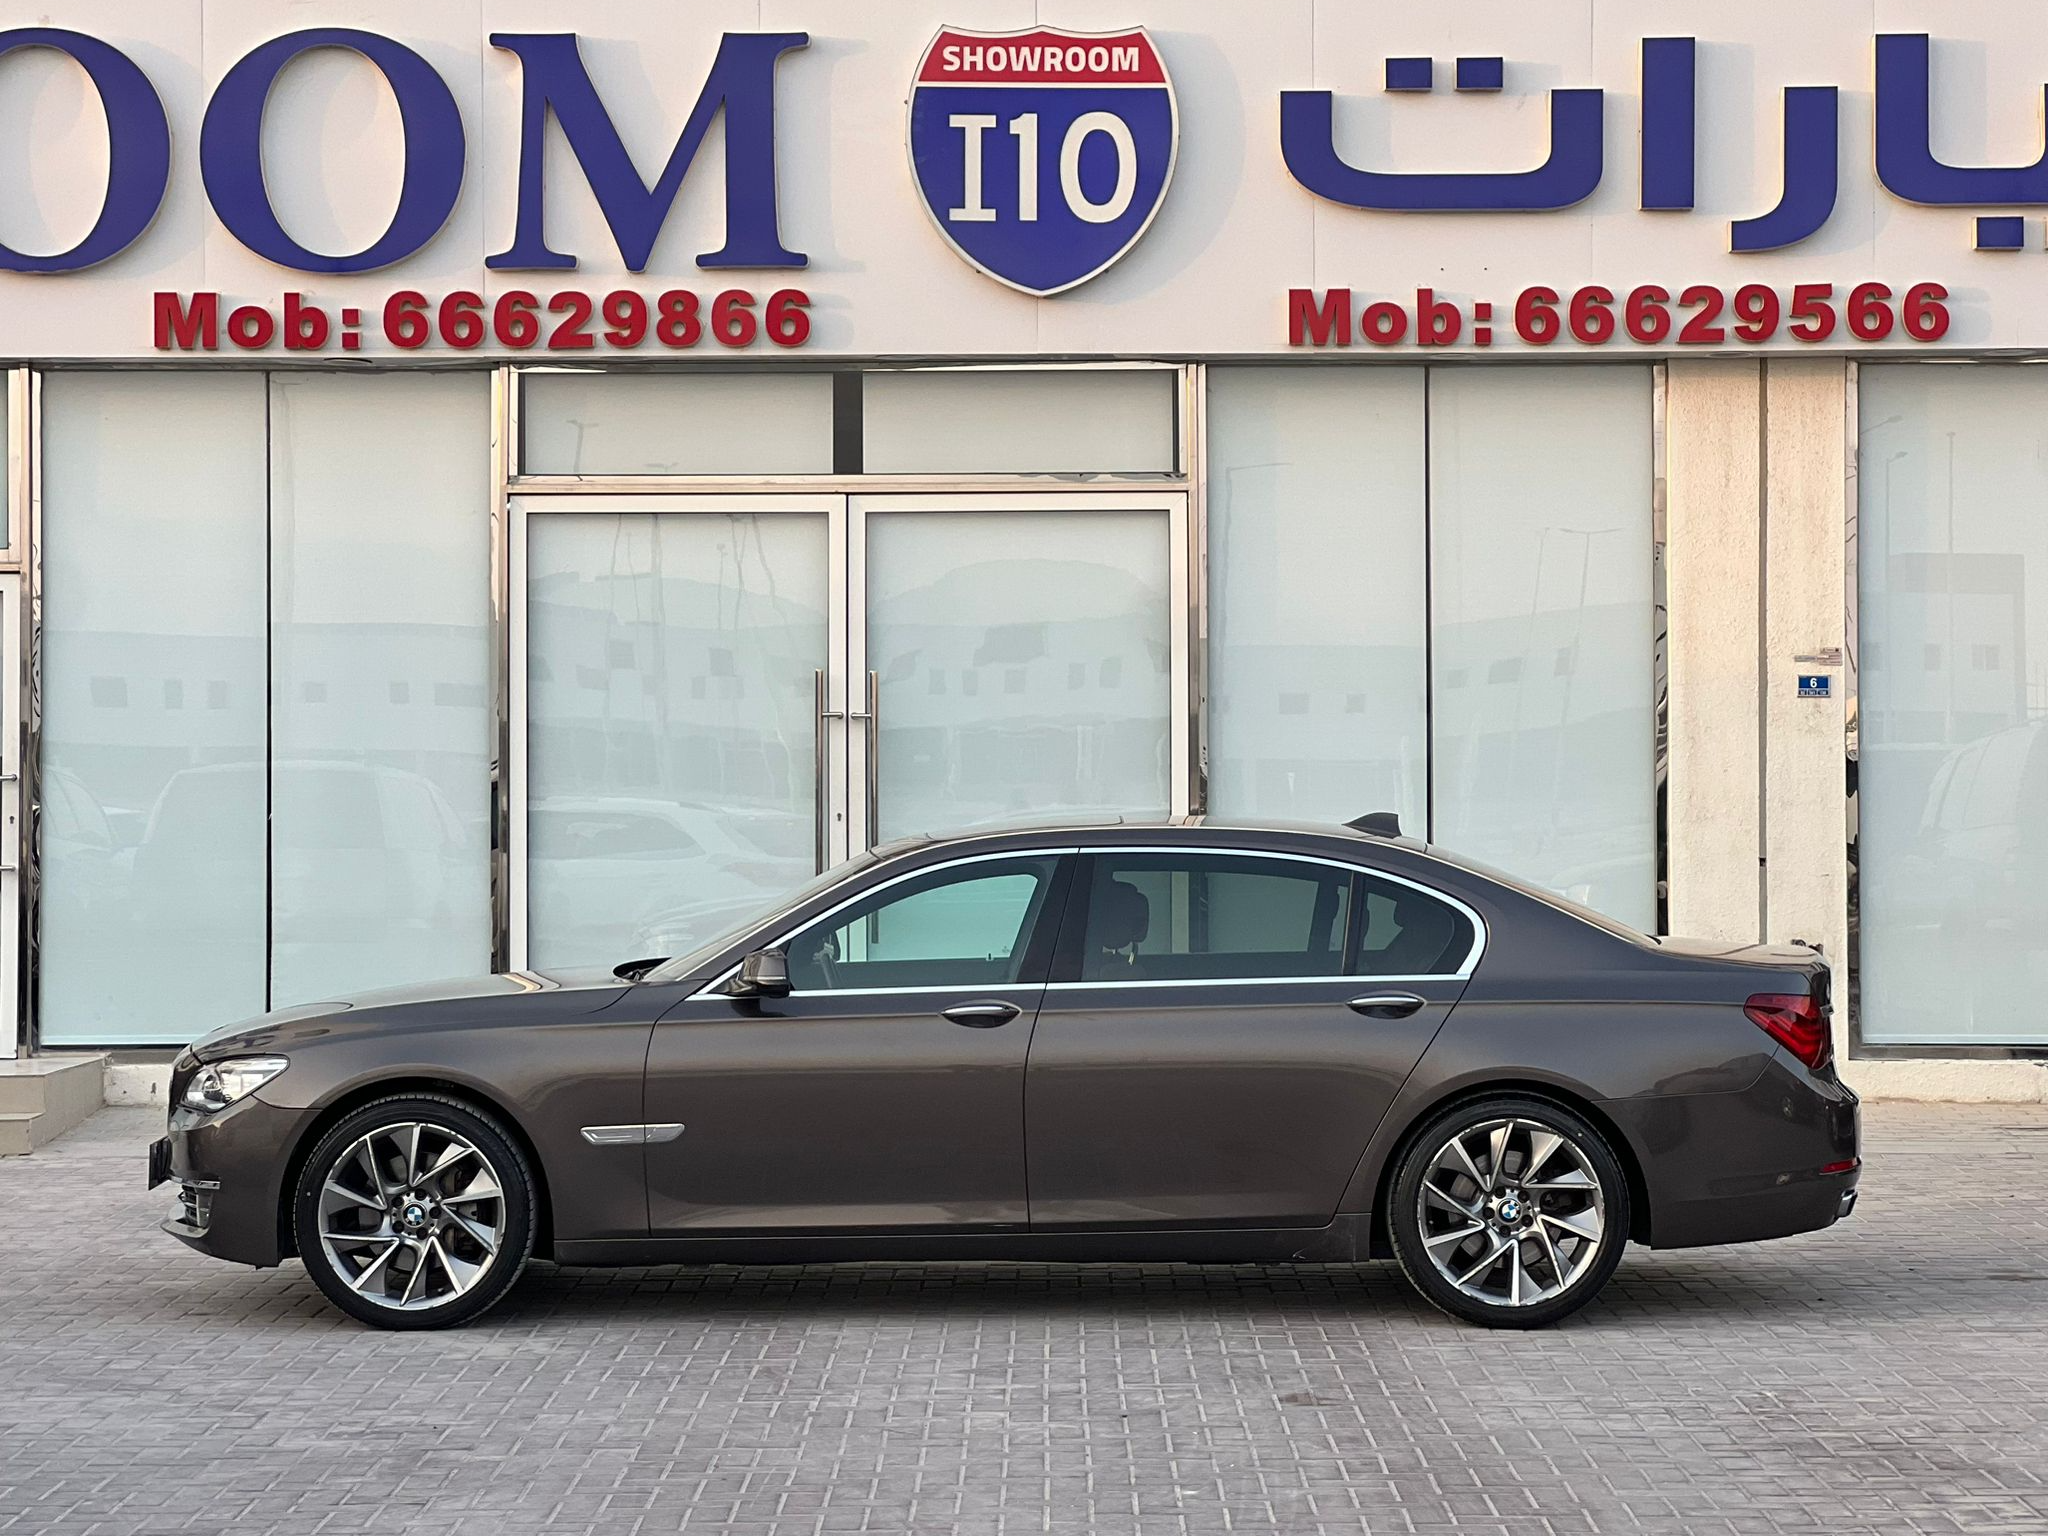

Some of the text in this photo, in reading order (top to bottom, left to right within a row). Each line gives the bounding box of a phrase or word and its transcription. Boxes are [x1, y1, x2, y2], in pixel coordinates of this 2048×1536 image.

[942, 46, 1139, 72] SHOWROOM
[949, 111, 1137, 223] I10
[1810, 677, 1817, 688] 6
